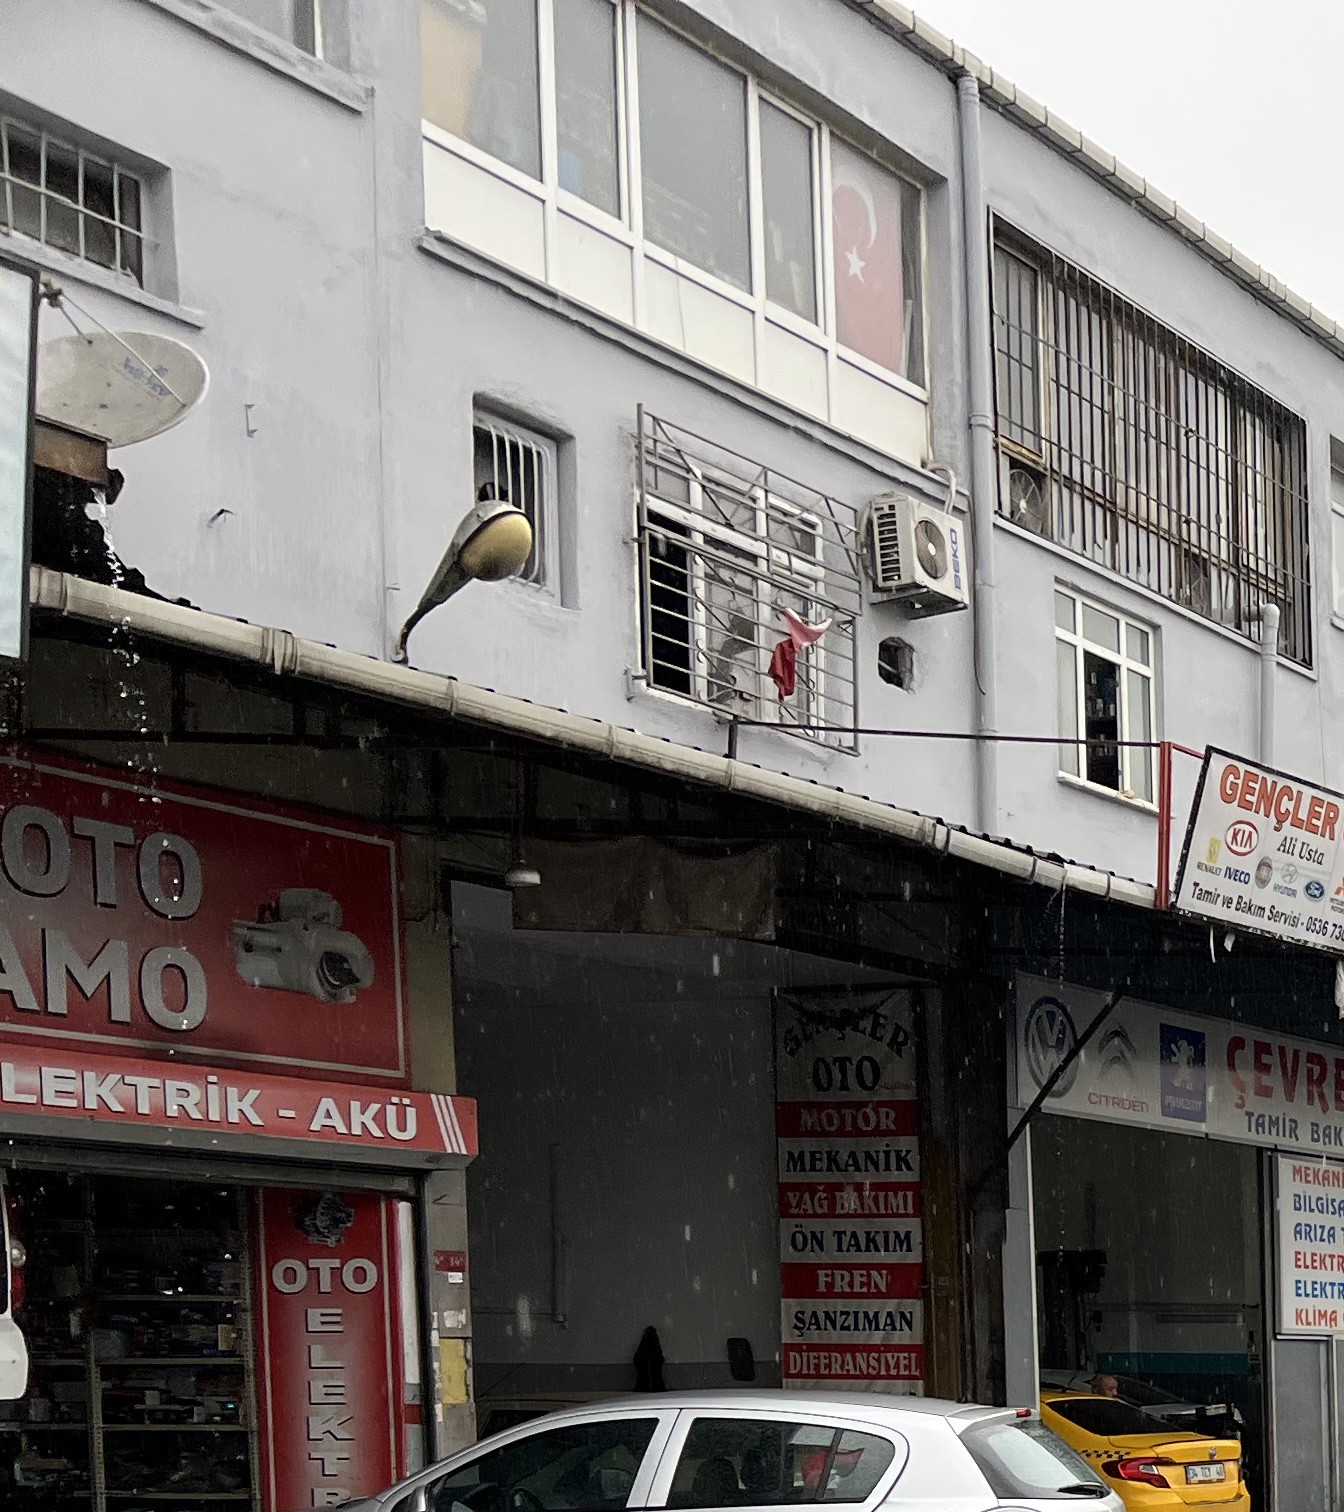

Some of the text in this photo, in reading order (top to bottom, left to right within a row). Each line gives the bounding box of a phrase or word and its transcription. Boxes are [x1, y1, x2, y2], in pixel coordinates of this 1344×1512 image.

[1219, 764, 1340, 841] GENÇLER
[1230, 827, 1253, 849] KIA
[1277, 835, 1325, 866] Ali Usta
[1, 805, 203, 921] OTO
[1224, 866, 1251, 885] IVECO
[1191, 881, 1221, 906] Tamir
[1222, 894, 1233, 909] ve
[1235, 895, 1265, 920] Bakım
[1267, 905, 1300, 929] Servisi
[1306, 916, 1329, 937] 0536
[812, 1056, 881, 1092] OTO
[1, 1062, 265, 1127] LEKTRİK
[309, 1097, 418, 1141] AKÜ
[800, 1105, 897, 1132] MOTOR
[1245, 1110, 1299, 1141] TAMİR
[785, 1143, 914, 1173] MEKANİK
[786, 1184, 914, 1215] YAĞ BAKIMI
[791, 1223, 913, 1253] ÖN TAKIM
[1294, 1223, 1336, 1245] ARIZA
[272, 1258, 378, 1294] OTO
[816, 1269, 889, 1293] FREN
[793, 1310, 914, 1337] ŞANZIMAN
[1295, 1305, 1338, 1329] KLİMA
[789, 1345, 921, 1376] DİFERANSİYEL
